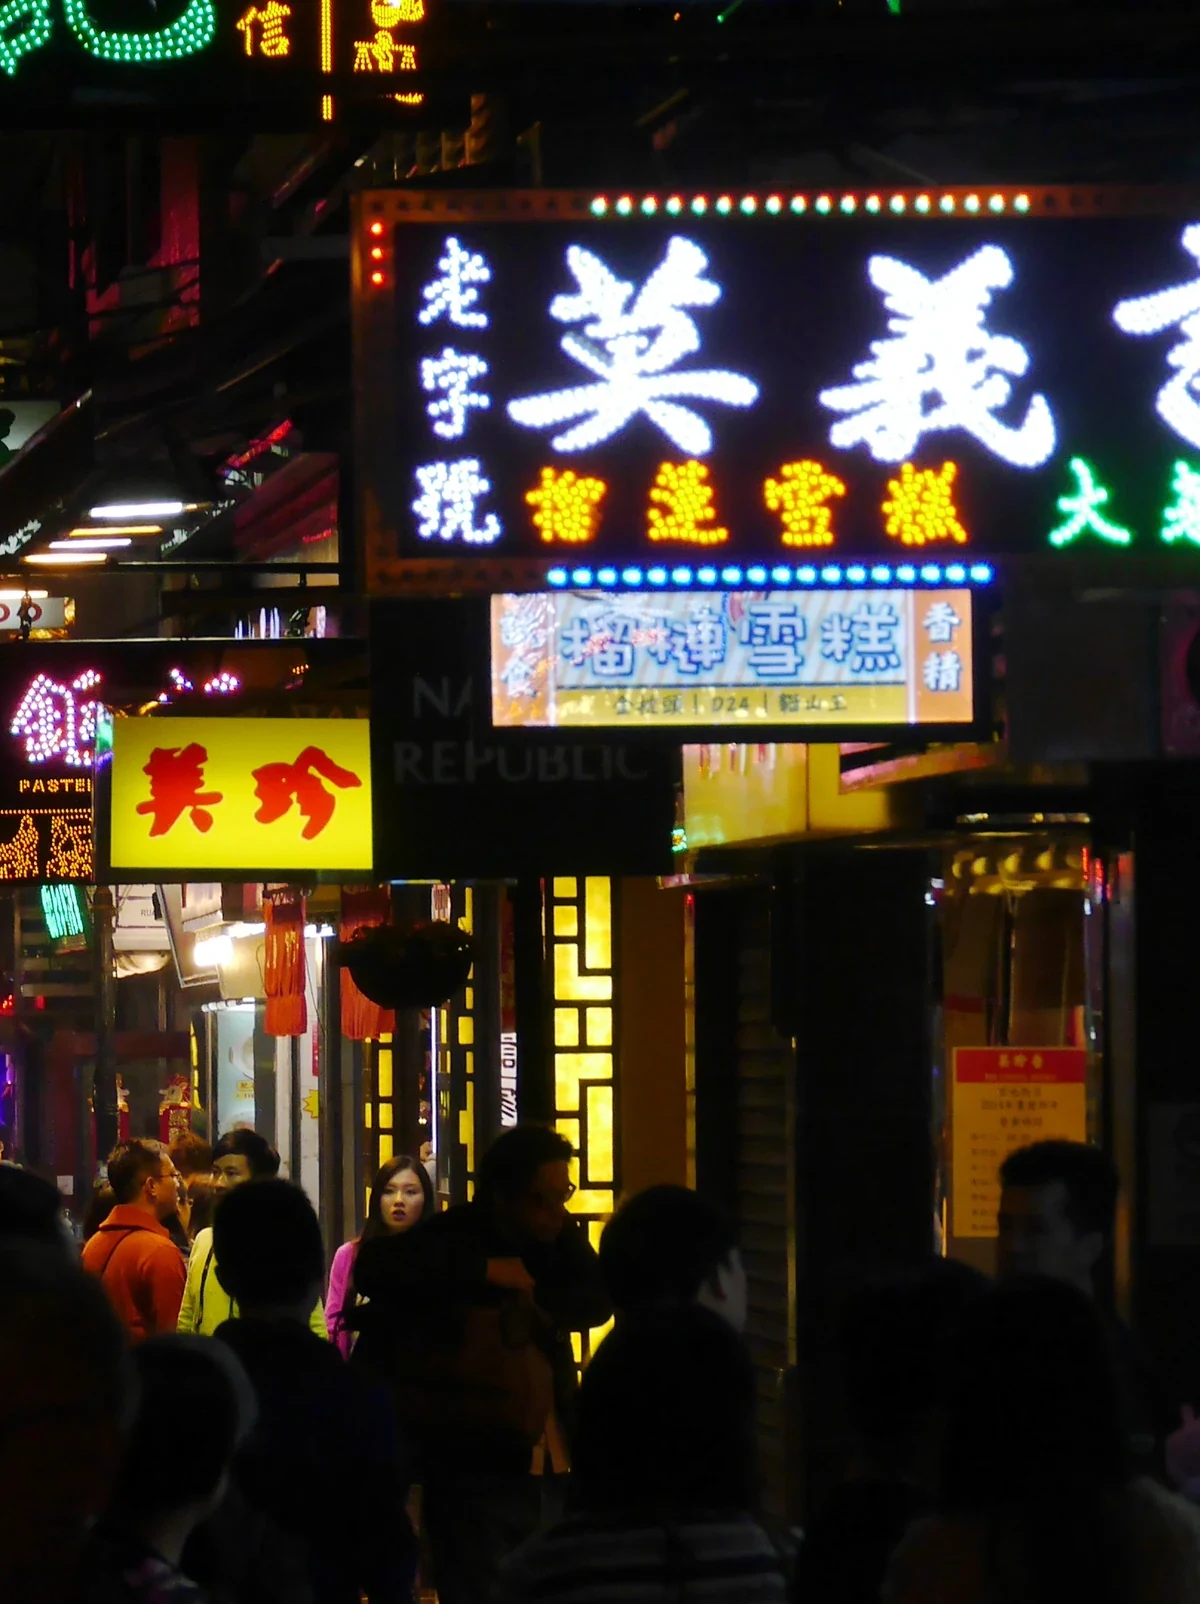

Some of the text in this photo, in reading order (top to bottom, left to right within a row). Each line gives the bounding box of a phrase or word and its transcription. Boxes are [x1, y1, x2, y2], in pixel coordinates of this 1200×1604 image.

[412, 237, 501, 544] 老字號
[922, 602, 962, 692] 香精
